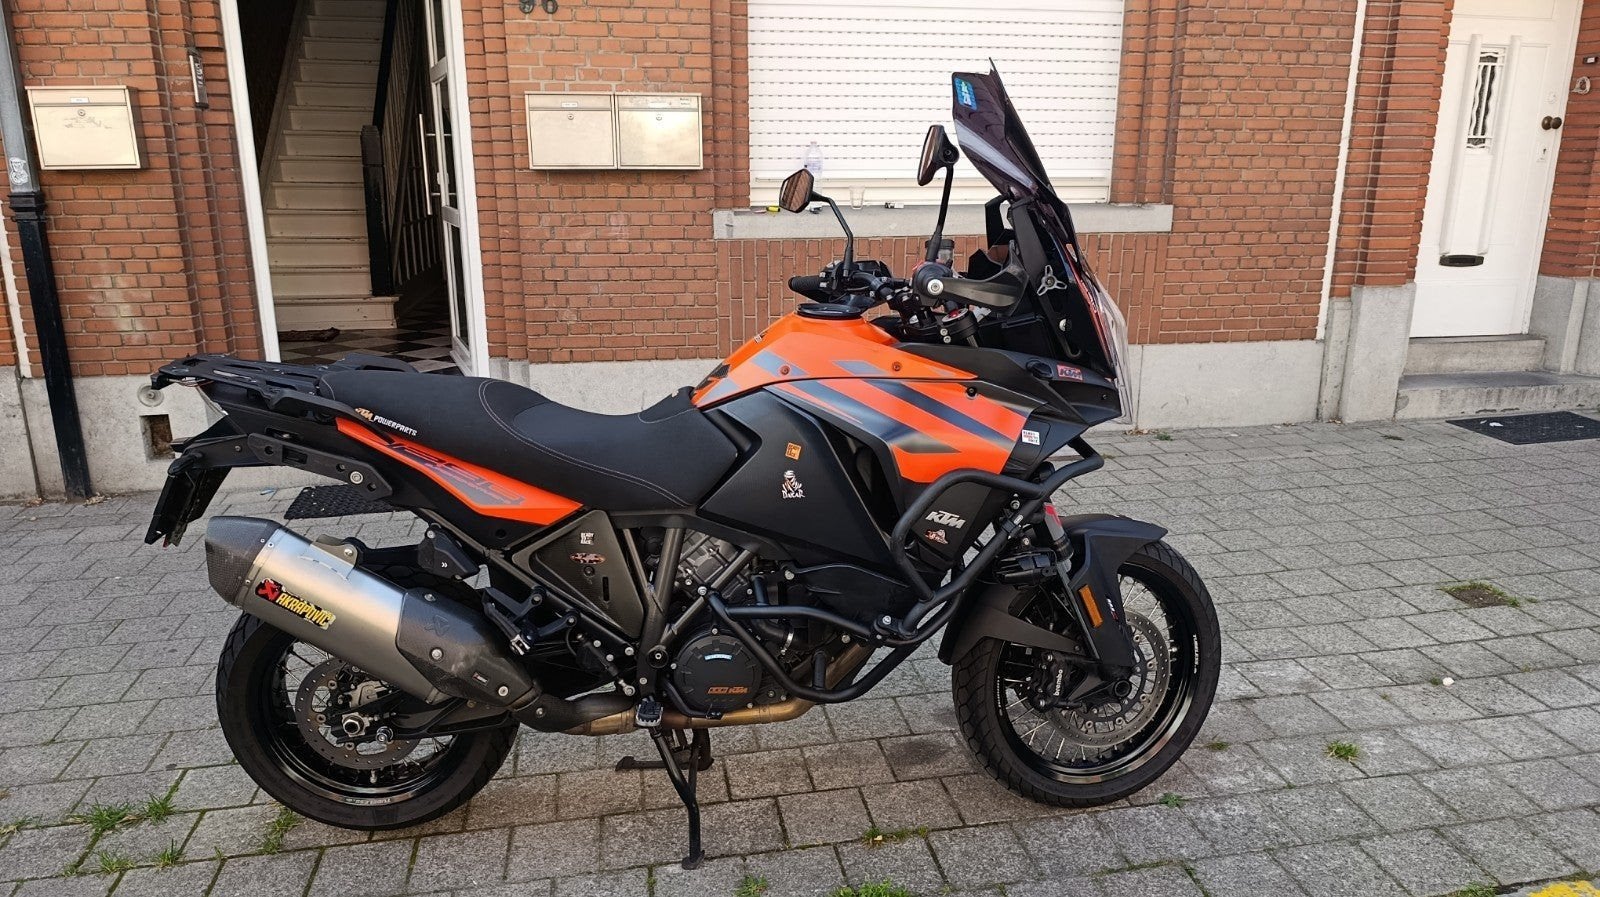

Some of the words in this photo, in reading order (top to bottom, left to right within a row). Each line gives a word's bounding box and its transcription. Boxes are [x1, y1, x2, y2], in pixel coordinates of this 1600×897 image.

[374, 415, 418, 437] POWERPARTS
[925, 510, 966, 529] KTM
[1053, 669, 1063, 696] brembo
